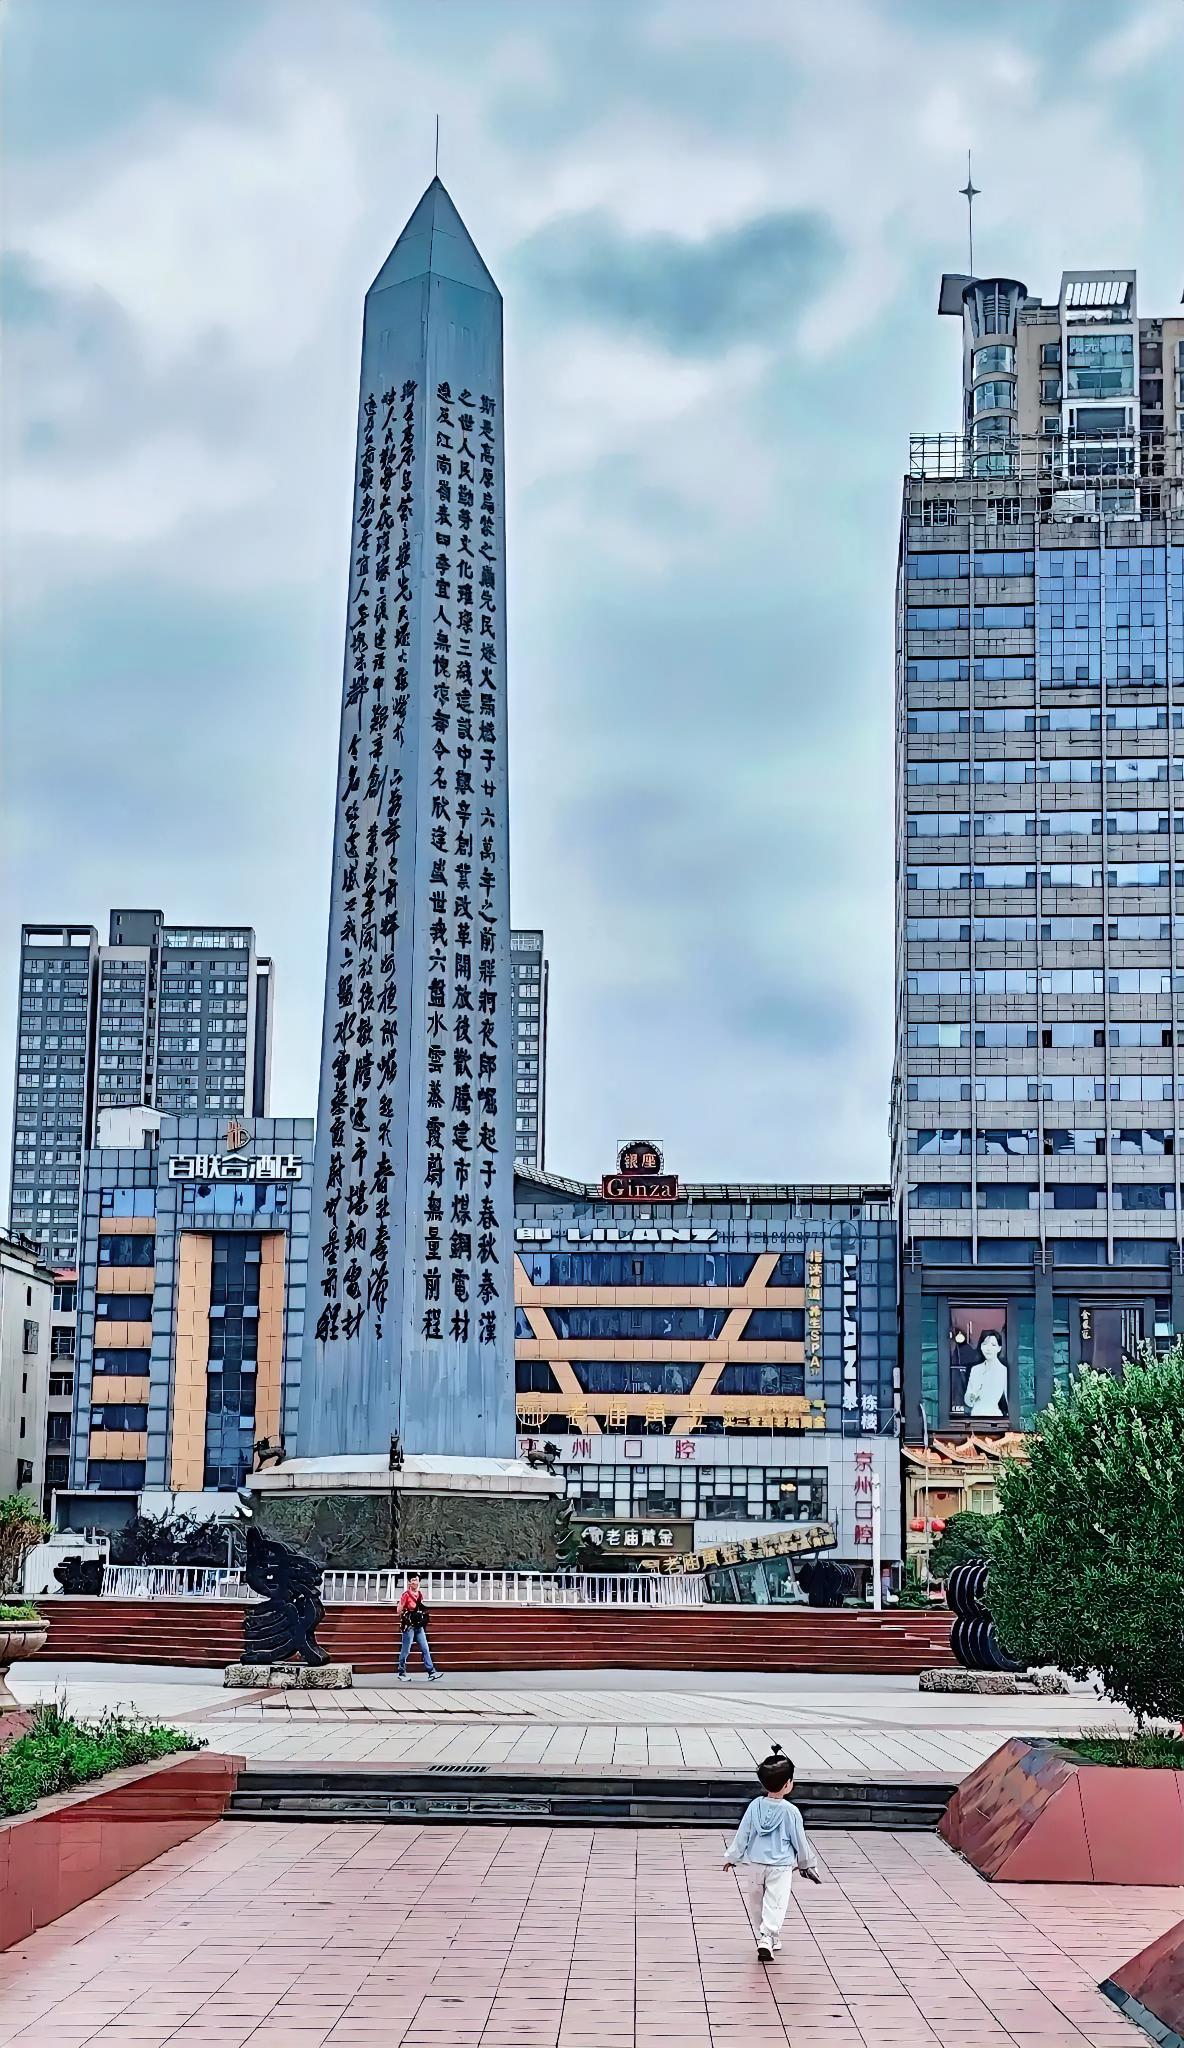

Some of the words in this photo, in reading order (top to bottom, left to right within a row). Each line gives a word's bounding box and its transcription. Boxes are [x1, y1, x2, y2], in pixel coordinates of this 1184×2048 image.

[168, 1154, 302, 1179] 百联合酒店
[607, 1178, 672, 1197] Ginza
[567, 1228, 718, 1241] LILANZ
[854, 1451, 874, 1544] 京州口腔
